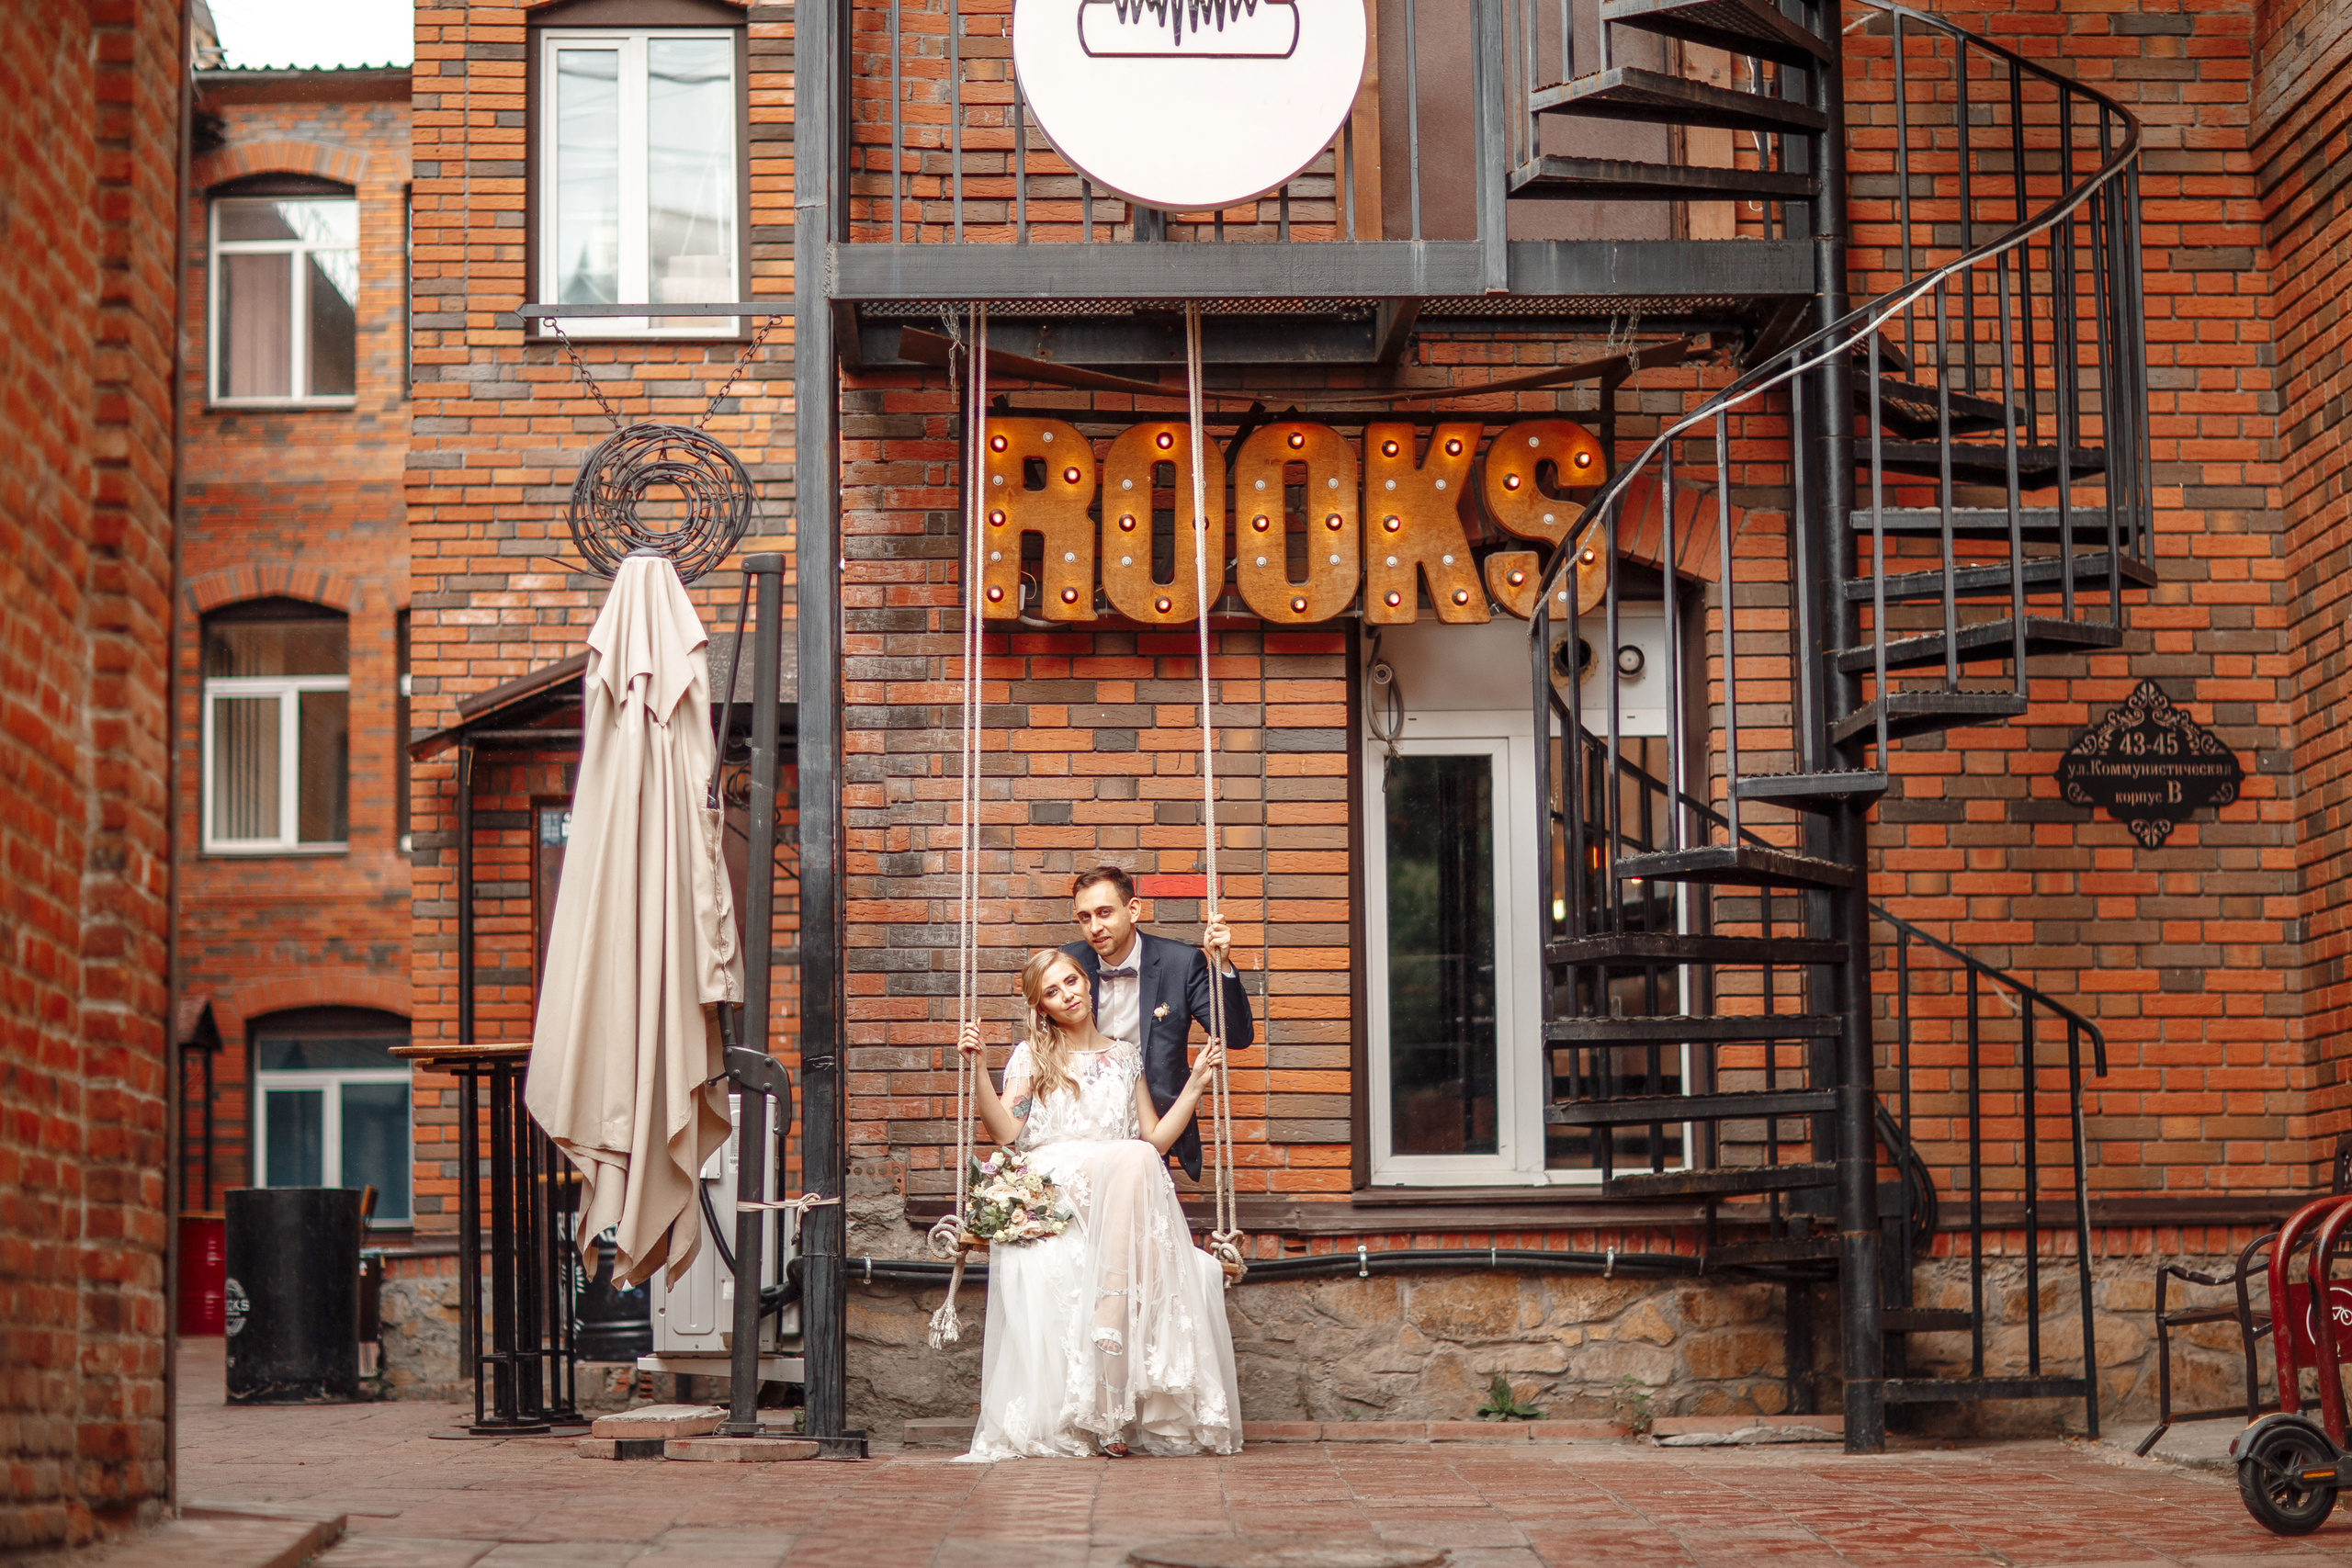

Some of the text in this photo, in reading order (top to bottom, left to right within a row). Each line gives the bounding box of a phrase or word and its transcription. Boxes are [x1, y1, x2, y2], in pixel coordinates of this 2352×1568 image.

[975, 418, 1608, 626] ROOKS
[2119, 731, 2179, 756] 43-45
[2115, 791, 2163, 807] корпус
